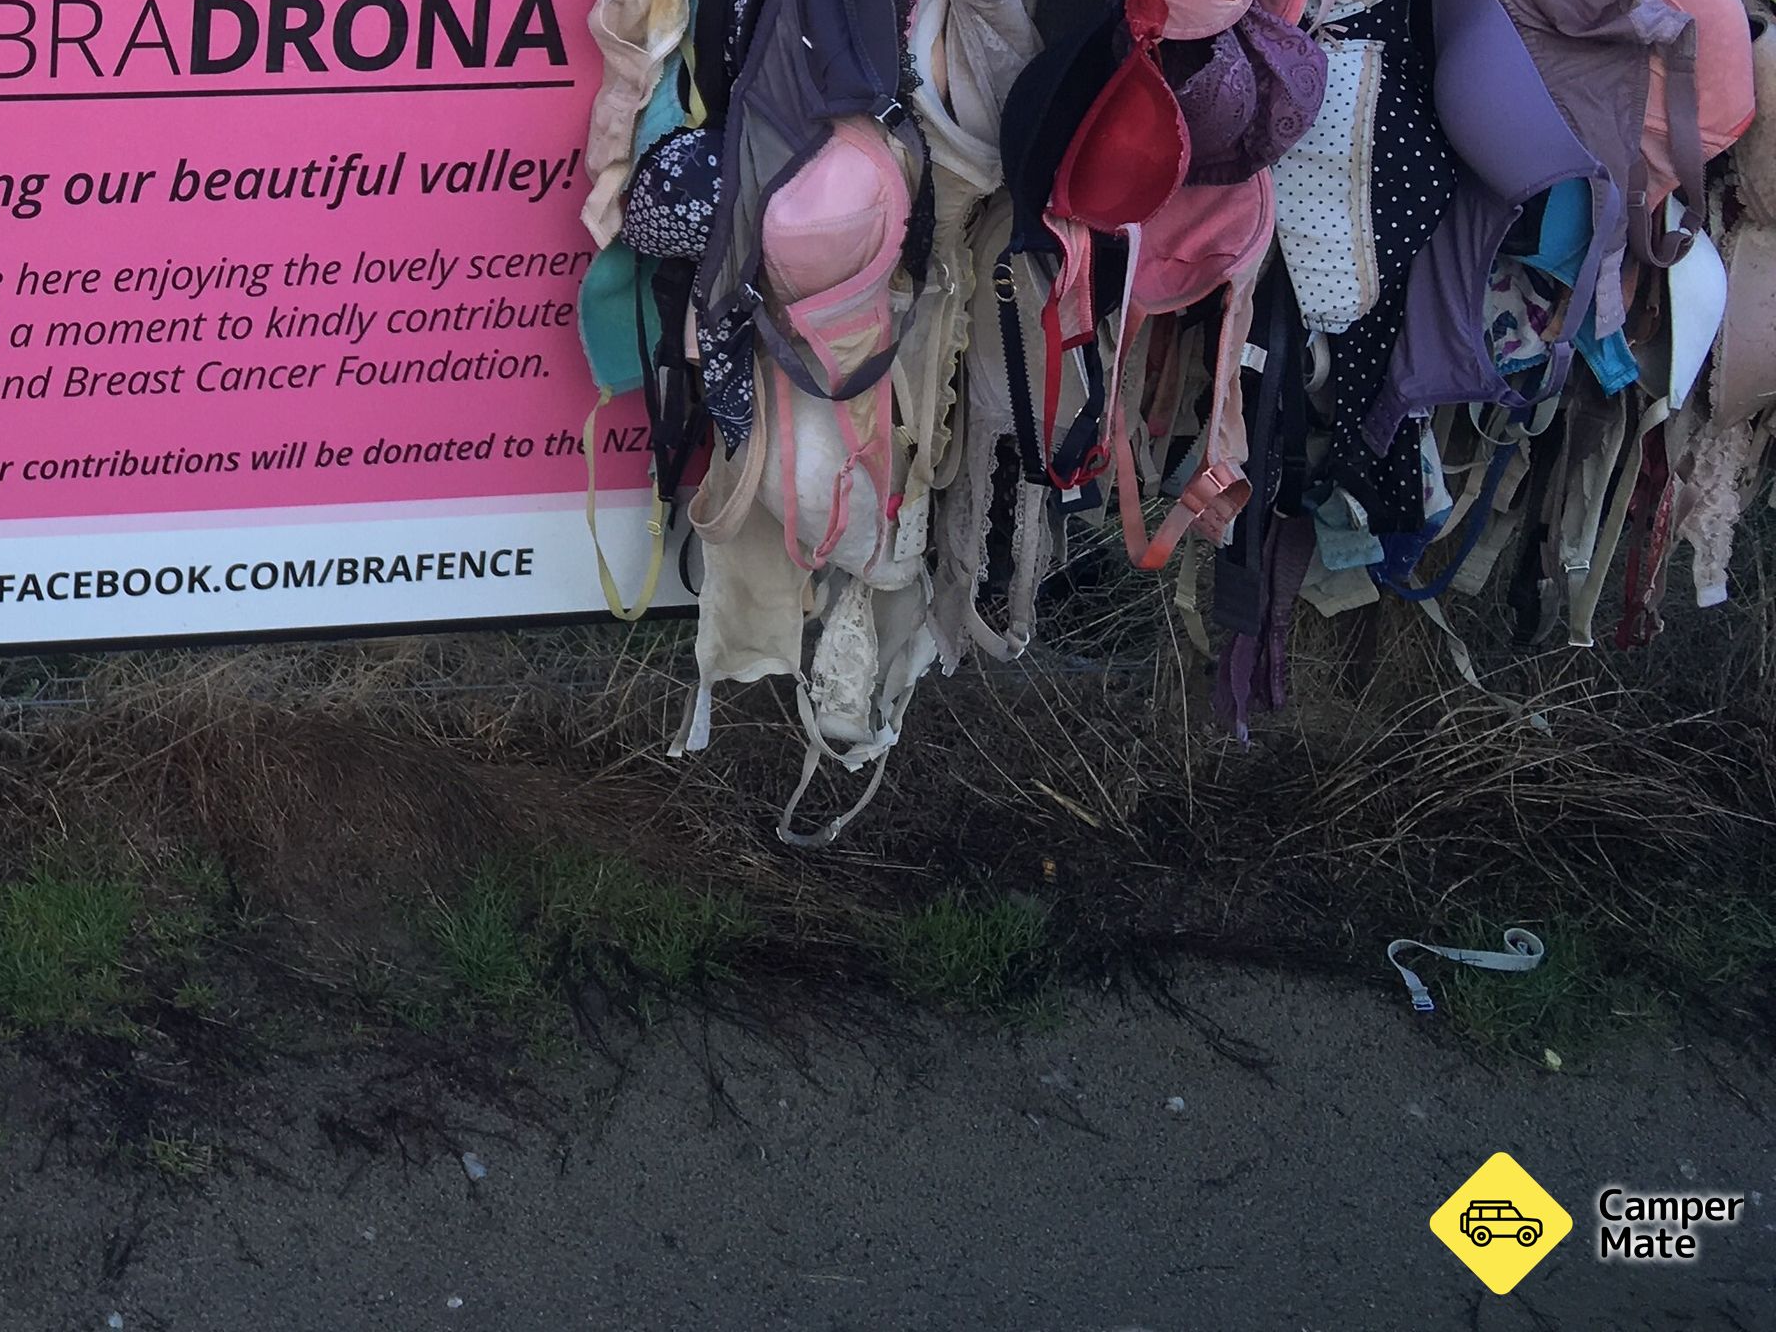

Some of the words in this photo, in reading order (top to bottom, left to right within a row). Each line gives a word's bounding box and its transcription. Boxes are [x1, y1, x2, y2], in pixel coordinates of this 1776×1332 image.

[65, 171, 156, 205] our
[169, 152, 406, 209] beautiful
[421, 149, 581, 202] valley!
[16, 263, 100, 295] here
[114, 258, 273, 300] enjoying
[284, 254, 341, 286] the
[353, 249, 459, 290] lovely
[467, 251, 591, 284] scener
[11, 324, 33, 347] a
[46, 314, 207, 346] moment
[218, 312, 252, 340] to
[266, 303, 377, 344] kindly
[388, 297, 574, 335] contribute
[64, 366, 185, 397] Breast
[197, 362, 325, 391] Cancer
[336, 349, 549, 386] Foundation.
[23, 448, 240, 480] contributions
[252, 442, 307, 470] will
[315, 441, 352, 467] be
[364, 433, 495, 464] donated
[504, 436, 533, 458] to
[544, 430, 584, 456] the
